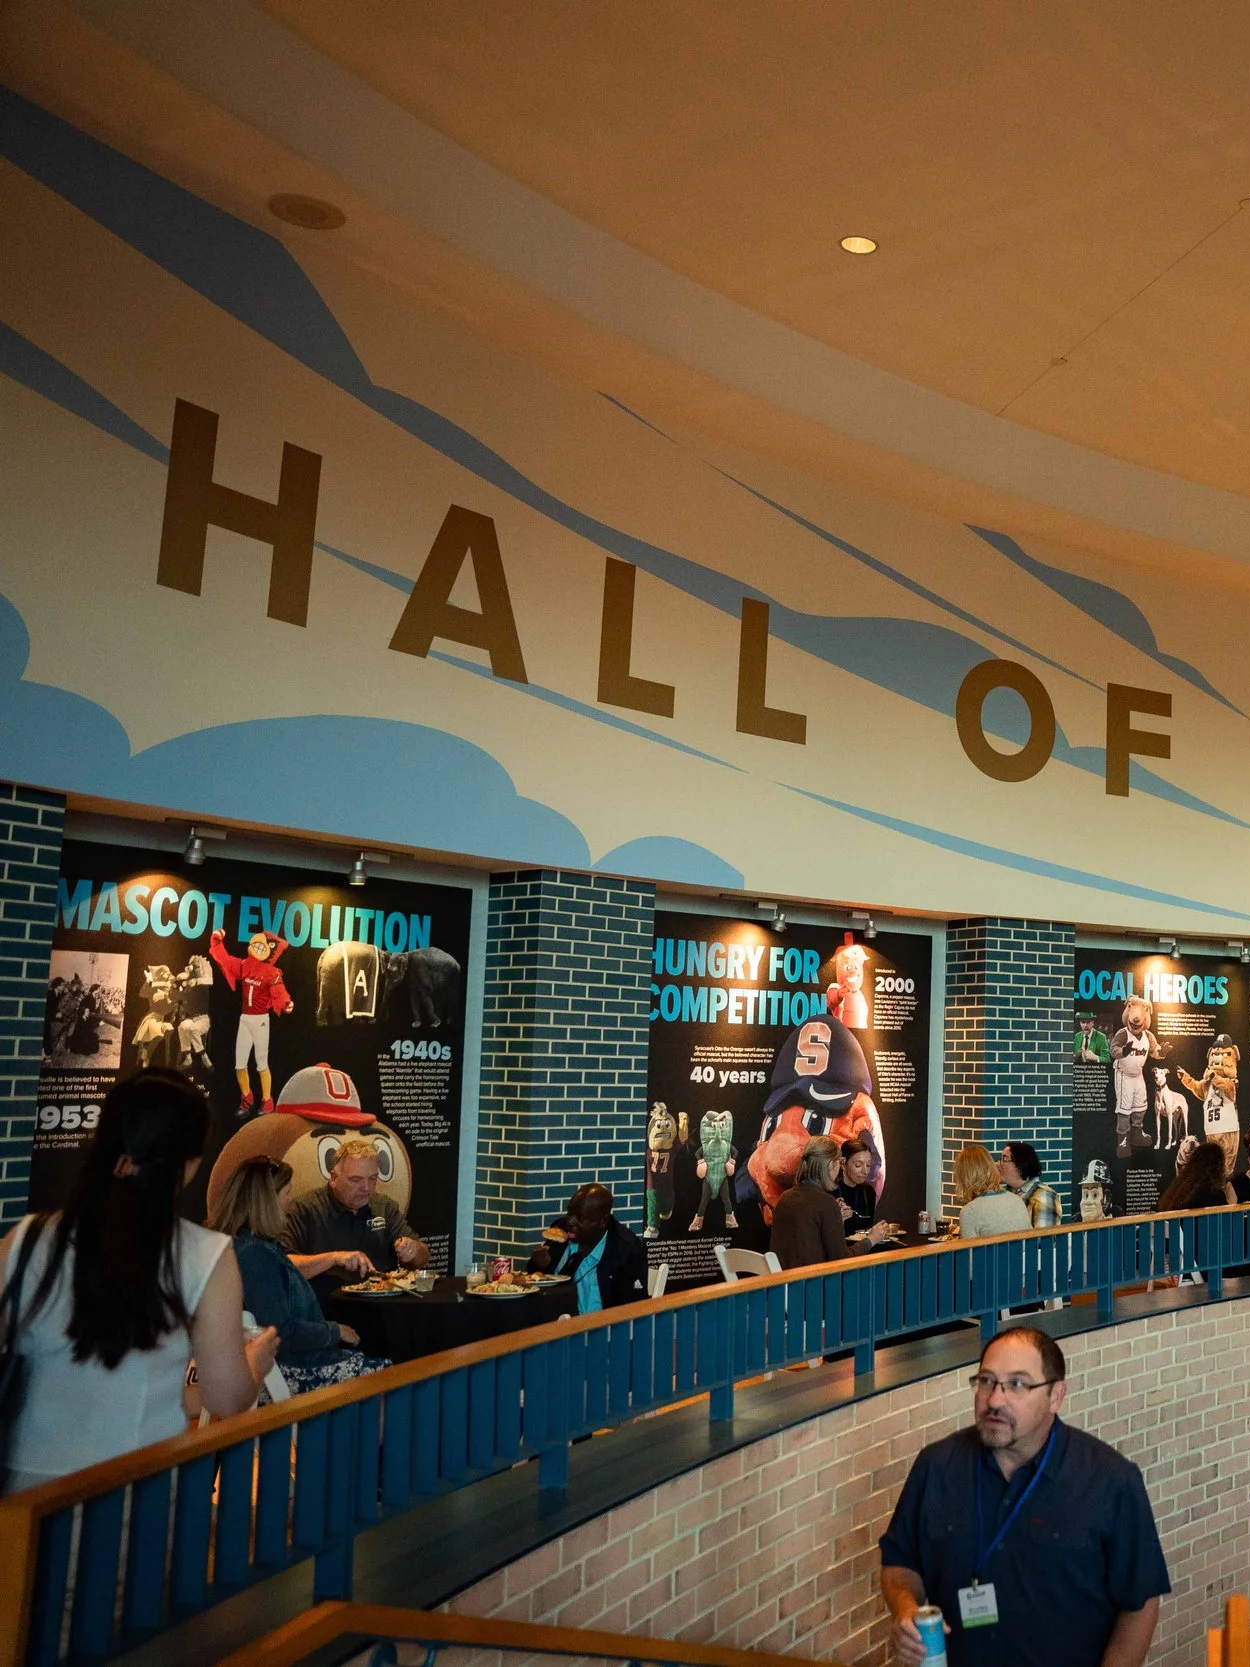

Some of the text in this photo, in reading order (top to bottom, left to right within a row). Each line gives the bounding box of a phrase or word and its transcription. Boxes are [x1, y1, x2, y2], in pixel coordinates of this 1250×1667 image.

[156, 397, 806, 745] HALL
[955, 658, 1172, 797] OF
[56, 877, 432, 954] MASCOT EVOLUTION
[652, 937, 820, 985] HUNGRY FOR
[353, 969, 369, 997] A
[874, 976, 915, 994] 2000
[1074, 969, 1229, 1006] OCAL HEROES
[649, 984, 828, 1027] COMPETITION
[390, 1040, 452, 1060] 1940s
[794, 1021, 832, 1076] S
[690, 1066, 766, 1087] 40 years
[35, 1105, 101, 1129] 953
[1208, 1109, 1220, 1122] 55
[650, 1152, 670, 1173] 77
